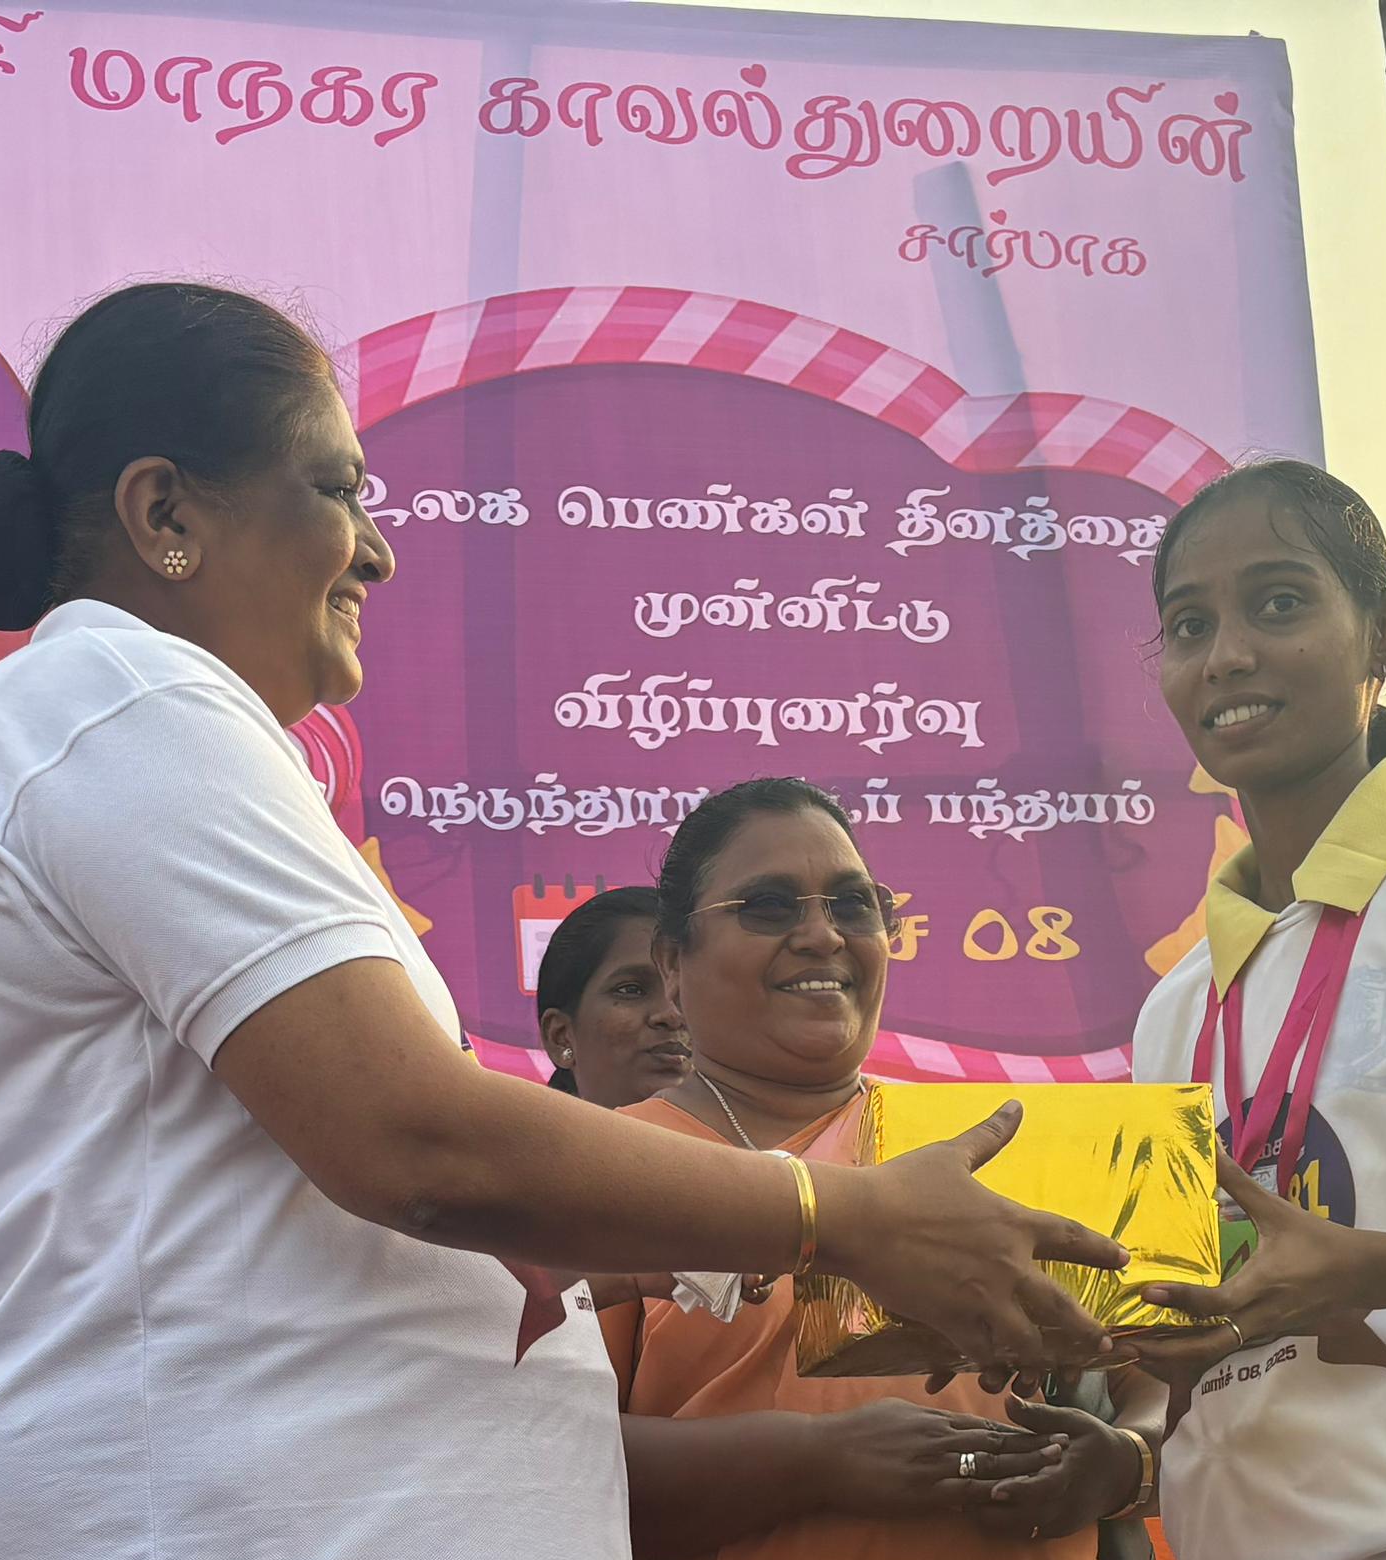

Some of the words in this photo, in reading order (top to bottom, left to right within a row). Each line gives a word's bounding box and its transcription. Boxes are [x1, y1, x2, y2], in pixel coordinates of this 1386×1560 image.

[69, 46, 438, 148] மாநகர
[478, 63, 1253, 186] காவல்துறையின்
[898, 208, 1147, 278] சார்பாக
[557, 483, 869, 538] பெண்கள்
[884, 485, 1167, 567] தினத்தை
[633, 574, 950, 644] முன்னிட்டு
[553, 669, 985, 755] விழிப்புணர்வு
[925, 776, 1156, 842] பந்தயம்
[963, 905, 1081, 961] 08
[1237, 1363, 1262, 1383] 08,
